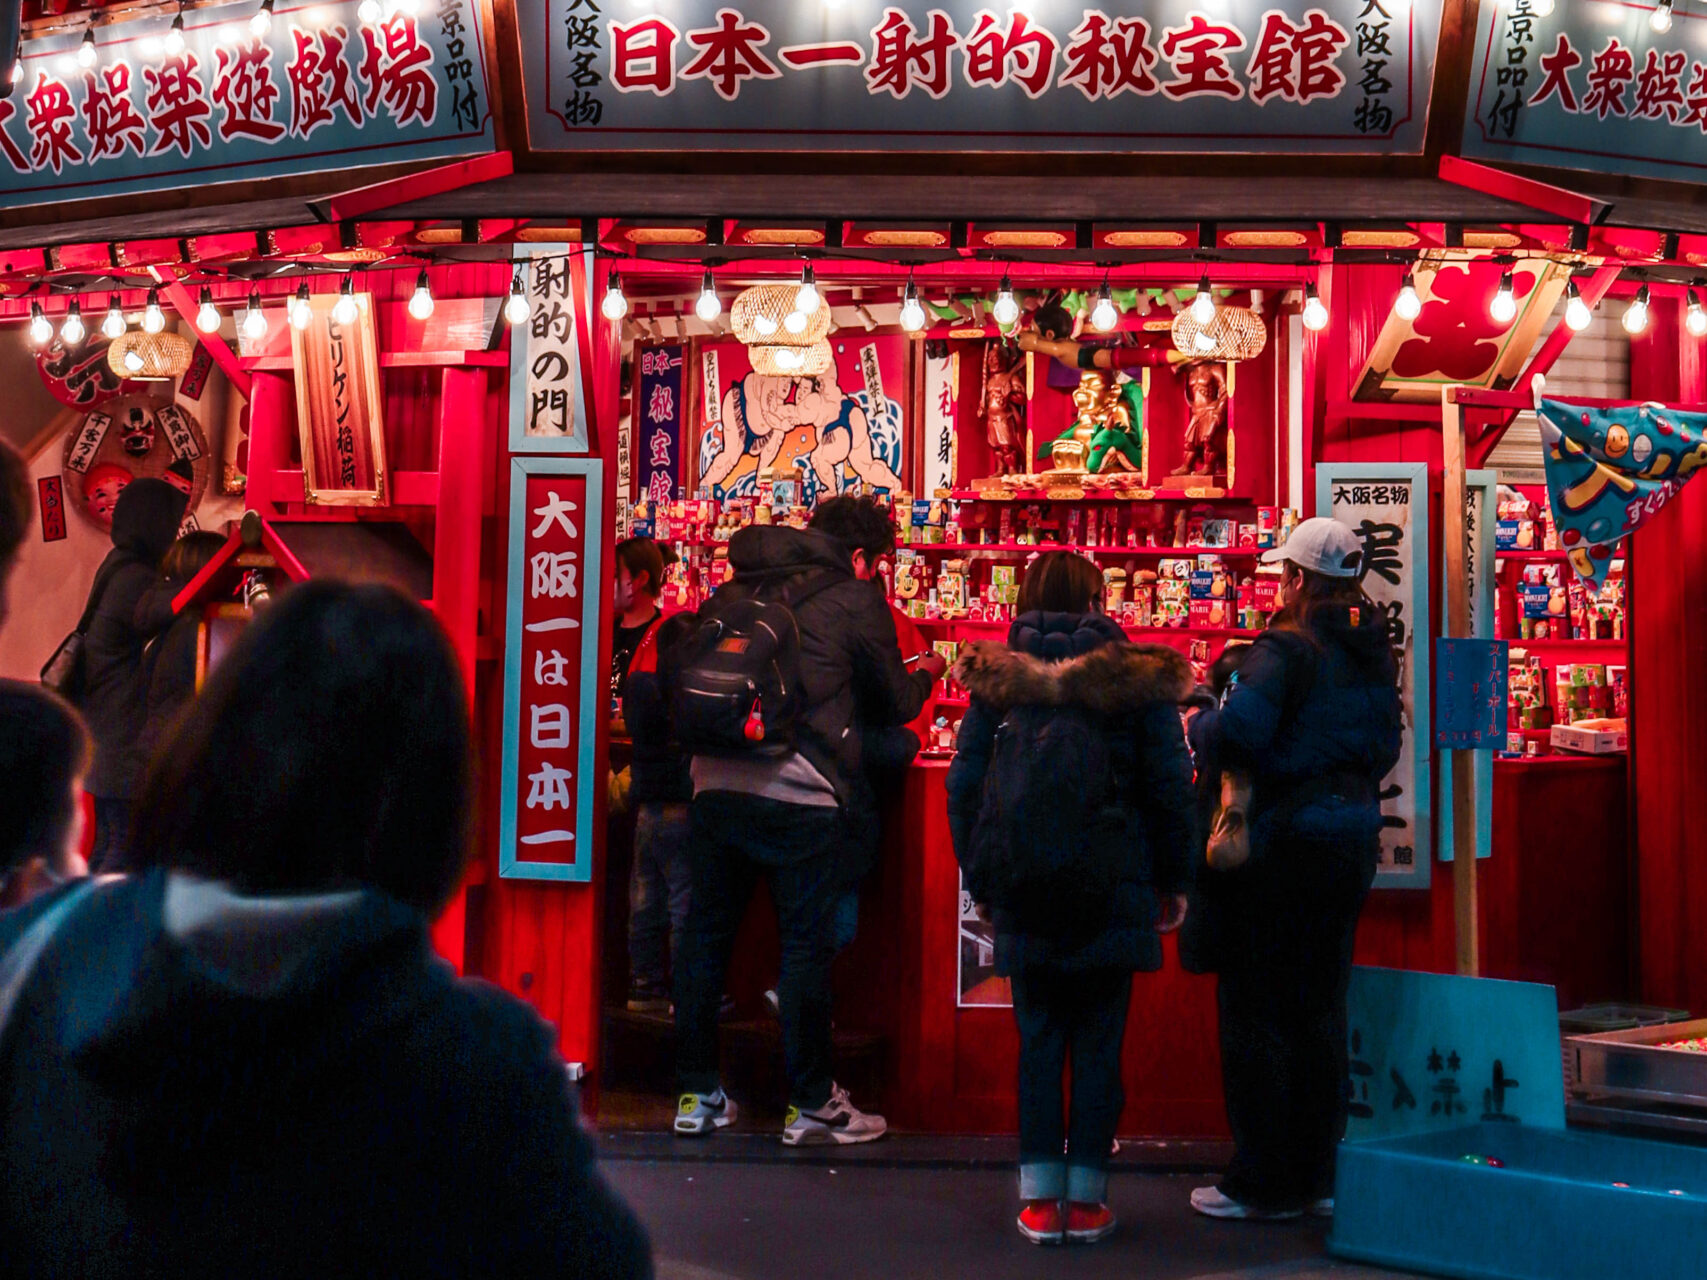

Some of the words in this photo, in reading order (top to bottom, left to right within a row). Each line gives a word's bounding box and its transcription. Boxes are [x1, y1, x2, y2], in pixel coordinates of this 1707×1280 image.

[607, 7, 1351, 106] 日本一射的秘宝館
[531, 256, 573, 432] 射的の門
[642, 349, 683, 376] 日本一
[863, 347, 885, 418] 実弾禁止
[71, 414, 108, 471] 千客万来
[648, 384, 674, 507] 秘宝館
[1333, 485, 1410, 506] 大阪名物
[1255, 588, 1275, 596] MARIE
[520, 491, 580, 845] 大阪一は日本一
[1487, 642, 1502, 737] スーパーボール
